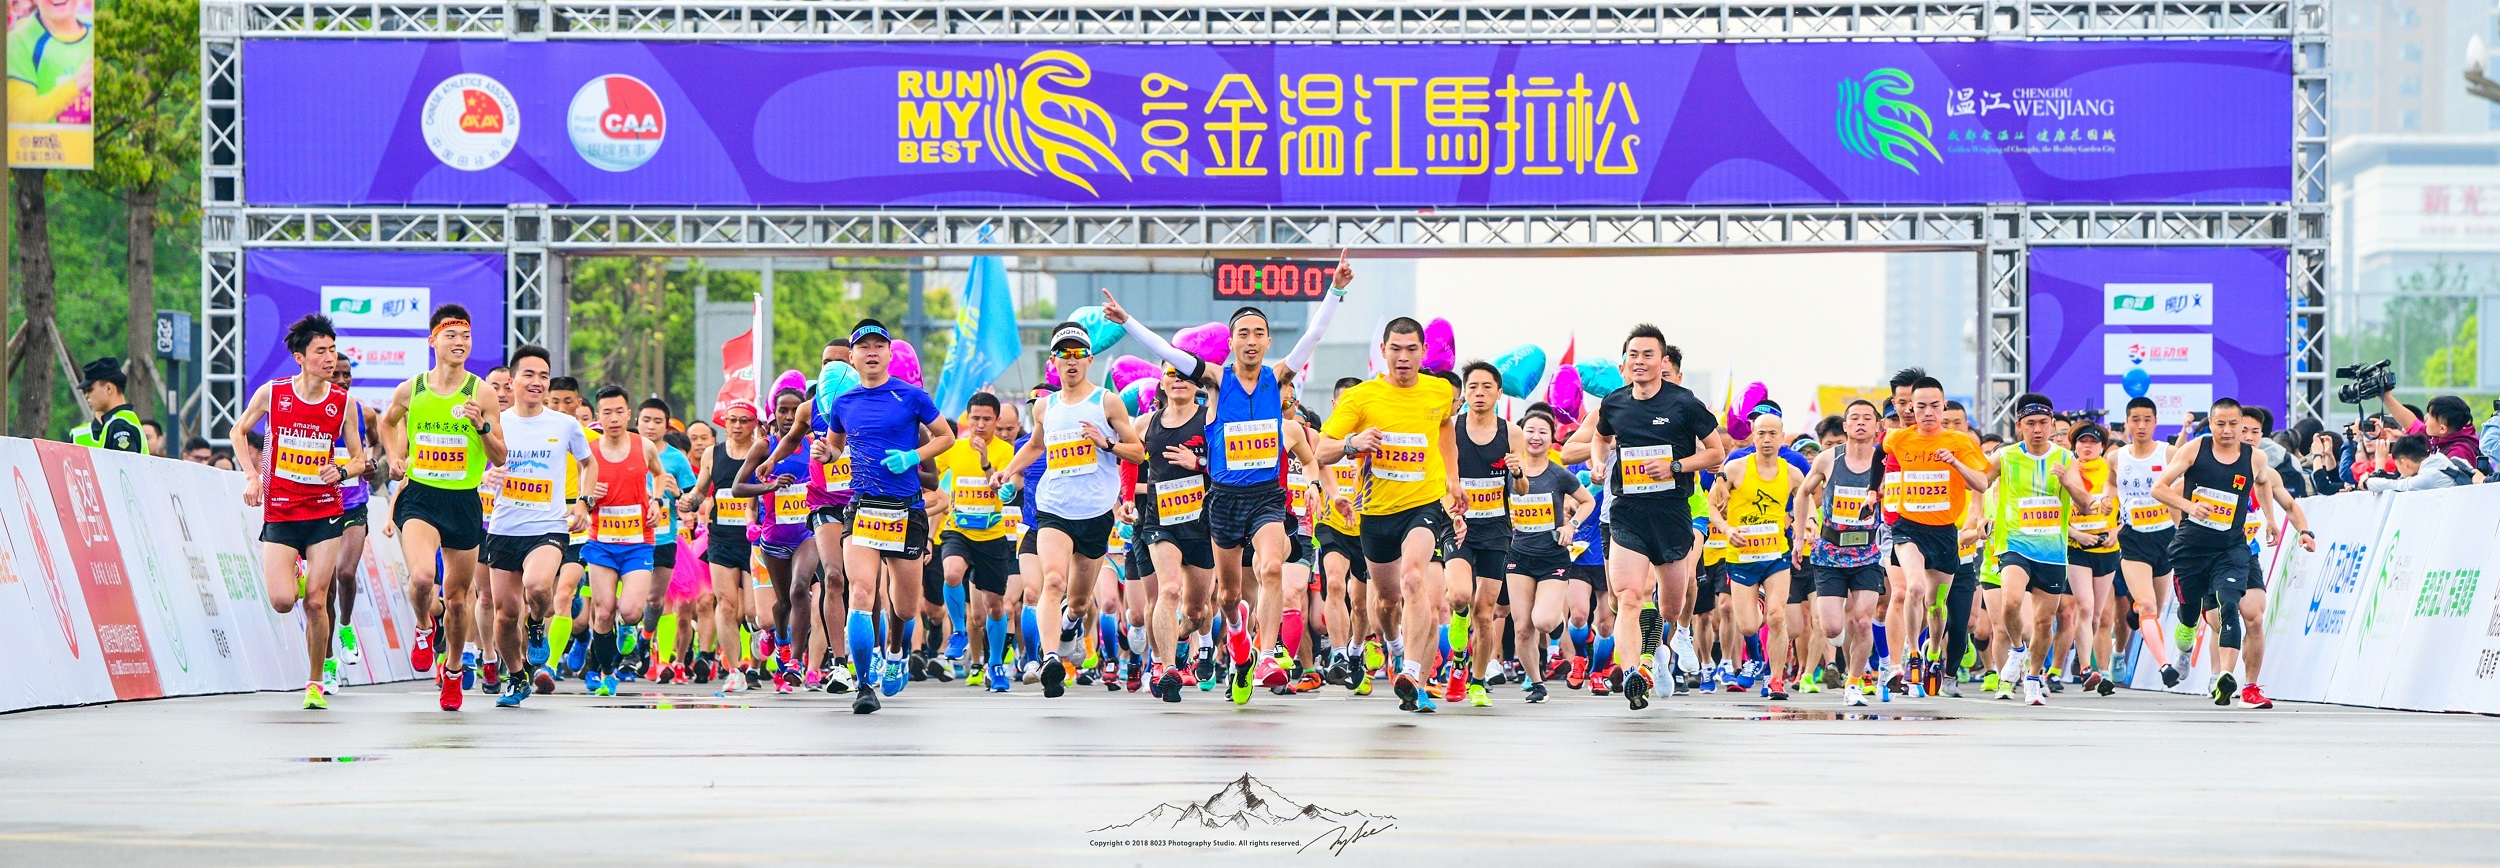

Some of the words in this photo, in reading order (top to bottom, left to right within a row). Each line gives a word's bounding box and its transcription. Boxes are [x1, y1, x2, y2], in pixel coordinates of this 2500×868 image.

[898, 70, 982, 98] RUN
[2012, 88, 2072, 98] CHENGDU
[426, 93, 443, 125] CHINESE
[442, 78, 482, 94] ATHLETICS
[485, 82, 515, 125] ASSOCIATION
[1947, 87, 2011, 117] 温江
[2012, 99, 2115, 120] WENJIANG
[574, 114, 596, 123] Road
[605, 113, 658, 133] CAA
[898, 101, 981, 139] MY
[1141, 72, 1189, 176] 2019
[1204, 73, 1641, 176] 金温江馬拉松
[574, 125, 596, 133] Race
[898, 141, 982, 163] BEST
[2420, 184, 2500, 217] 新光
[1218, 264, 1299, 296] 00:00
[278, 426, 333, 441] THAILAND
[292, 422, 320, 432] amazing
[1230, 437, 1276, 451] A11065
[281, 452, 327, 466] A10049
[418, 450, 465, 462] A10035
[1049, 444, 1092, 461] A10187
[1376, 449, 1425, 463] B12829
[1902, 451, 1955, 463] 达州跑
[506, 480, 549, 493] A10061
[1906, 486, 1948, 495] A10232
[958, 490, 995, 499] A11568
[1160, 491, 1203, 509] A10038
[2023, 510, 2059, 520] A10800
[2134, 507, 2170, 519] A10014
[602, 518, 640, 529] A10173
